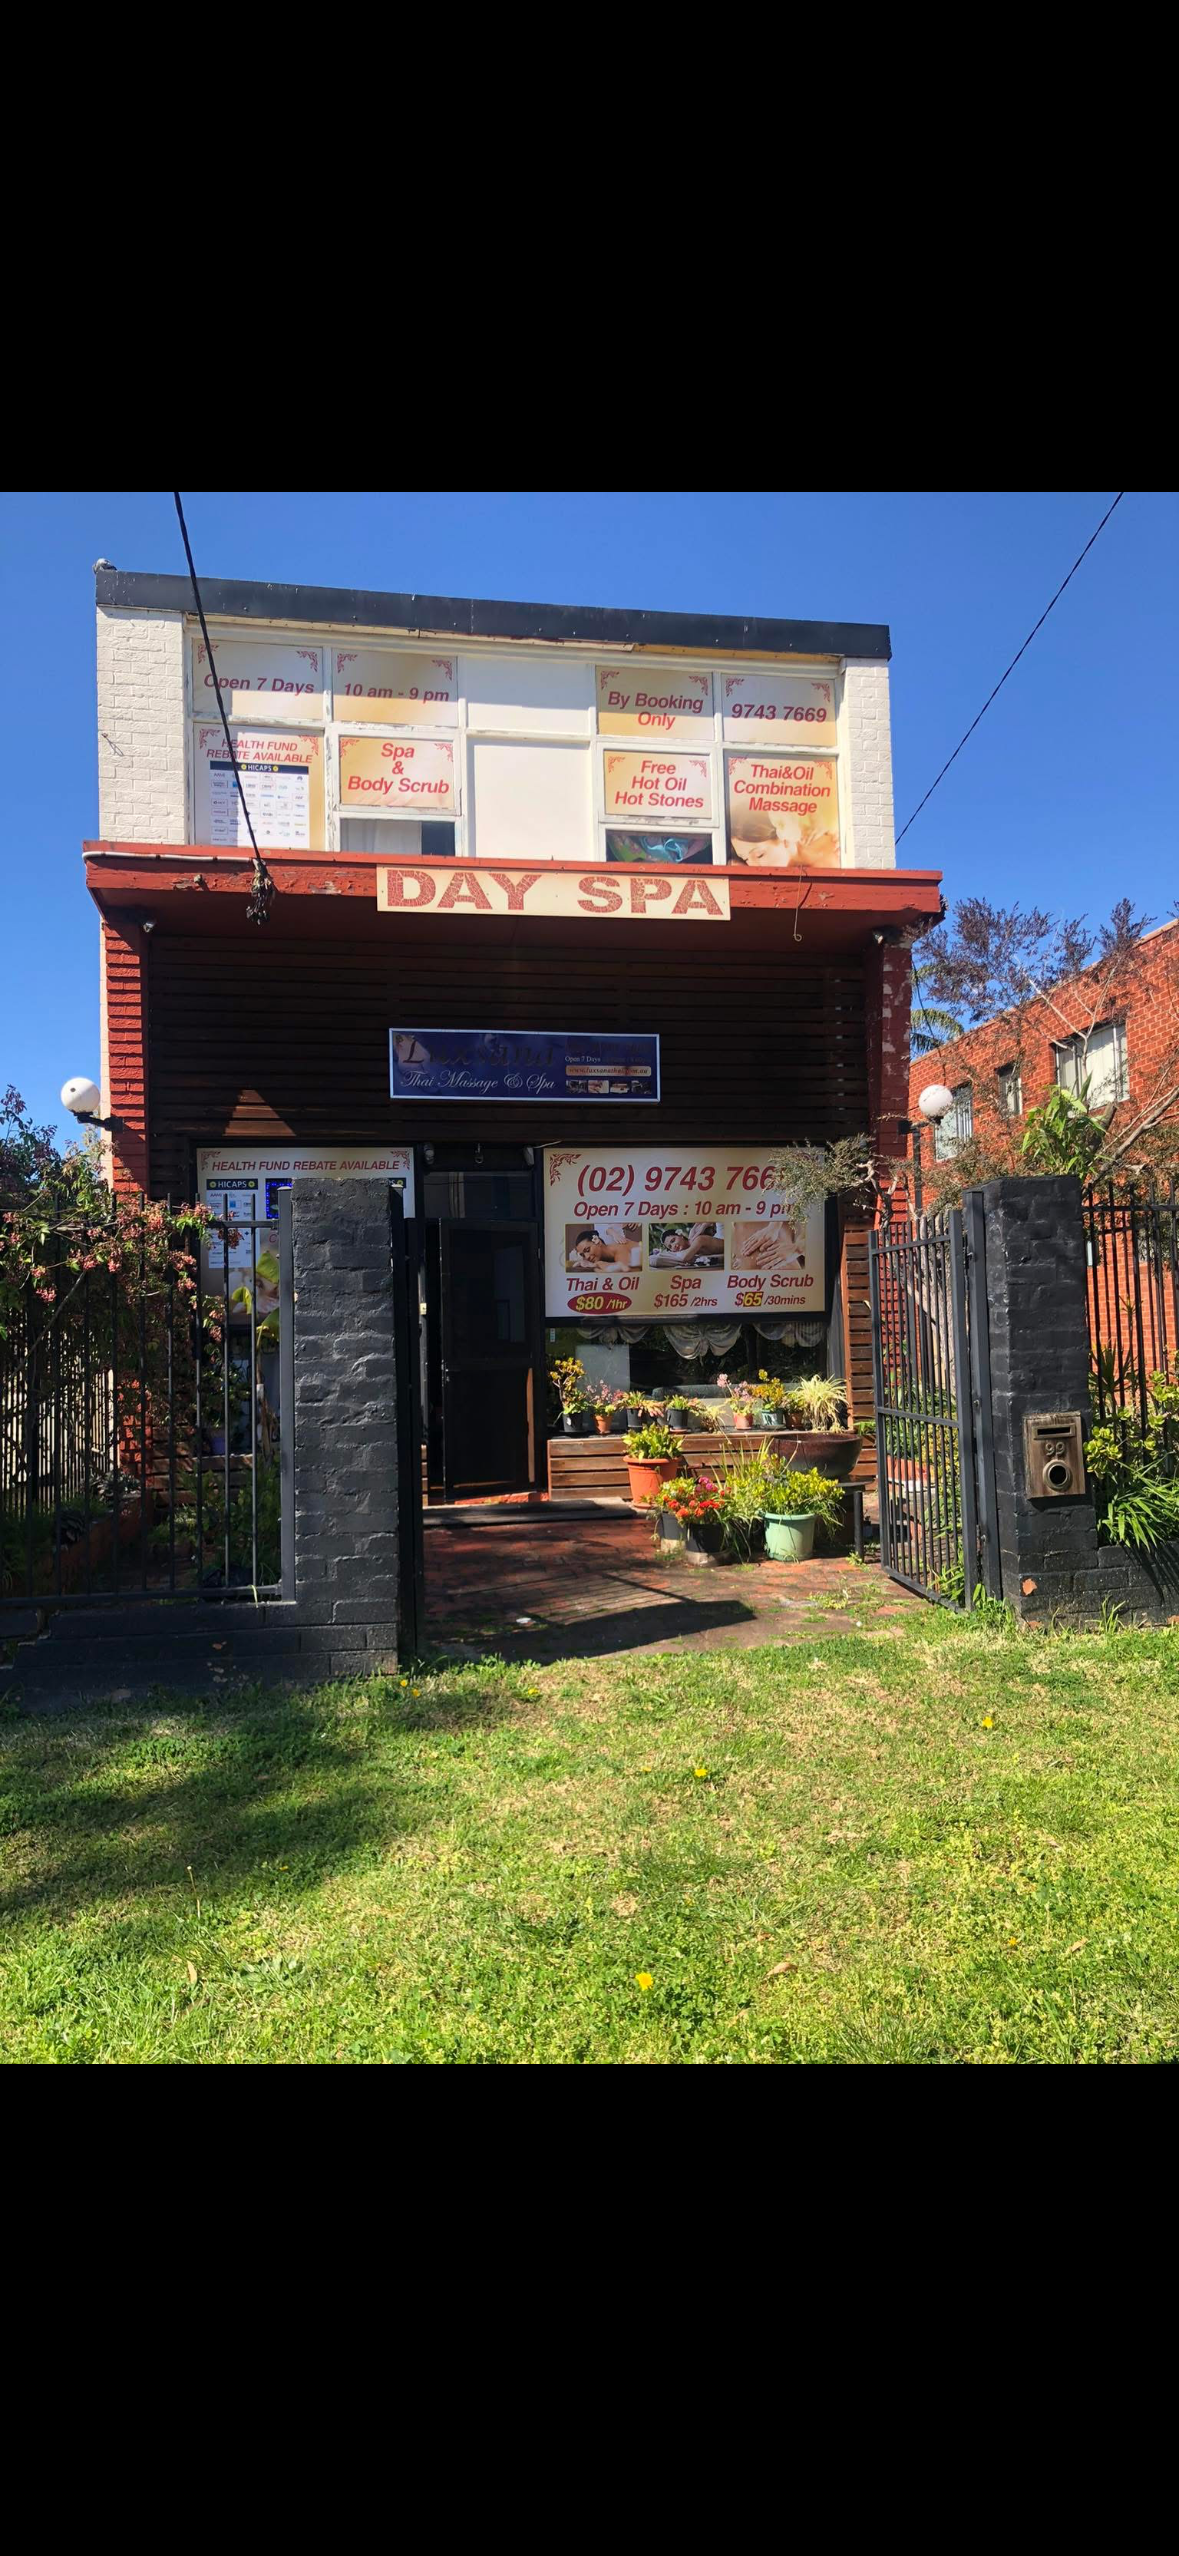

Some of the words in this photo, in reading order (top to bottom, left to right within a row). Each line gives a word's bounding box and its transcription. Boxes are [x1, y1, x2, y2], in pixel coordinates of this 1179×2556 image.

[204, 673, 251, 691] Open
[256, 677, 268, 691] 7
[271, 678, 315, 697] Days
[344, 683, 363, 697] 10
[368, 687, 394, 699] am
[408, 687, 419, 700] 9
[422, 691, 450, 705] pm
[607, 691, 631, 709] By
[634, 692, 704, 714] Booking
[637, 712, 676, 731] Only
[731, 703, 777, 721] 9743
[783, 706, 828, 724] 7669
[221, 738, 265, 750] HEALTH
[267, 741, 298, 752] FUND
[381, 742, 415, 761] Spa
[206, 748, 250, 760] REBATE
[253, 751, 313, 764] AVAILABLE
[247, 764, 272, 772] HICAPS
[391, 761, 404, 775] &
[640, 759, 677, 775] Free
[750, 764, 815, 781] Thai&Oil
[347, 776, 394, 795] Body
[397, 777, 450, 795] Scrub
[631, 775, 660, 791] Hot
[664, 776, 688, 792] Oil
[733, 780, 831, 798] Combination
[614, 791, 644, 807] Hot
[648, 792, 705, 809] Stones
[748, 797, 818, 816] Massage
[386, 869, 543, 911] DAY
[576, 875, 724, 916] SPA
[564, 1055, 580, 1064] Open
[586, 1055, 602, 1064] Days
[400, 1070, 435, 1089] Thai
[437, 1069, 499, 1095] Massage
[503, 1072, 524, 1090] &
[526, 1072, 557, 1095] Spa
[212, 1160, 256, 1171] HEALTH
[258, 1160, 291, 1171] FUND
[293, 1160, 337, 1171] REBATE
[340, 1160, 400, 1171] AVAILABLE
[217, 1180, 247, 1188] HICAPS
[577, 1164, 636, 1197] (02)
[644, 1166, 716, 1192] 9743
[725, 1165, 788, 1191] 766
[574, 1201, 619, 1220] Open
[623, 1202, 635, 1216] 7
[637, 1201, 679, 1220] Days
[694, 1201, 713, 1216] 10
[715, 1203, 741, 1216] am
[755, 1200, 766, 1215] 9
[566, 1276, 599, 1292] Thai
[602, 1277, 614, 1291] &
[618, 1276, 640, 1291] Oil
[670, 1275, 702, 1293] Spa
[727, 1275, 765, 1292] Body
[767, 1274, 814, 1289] Scrub
[575, 1296, 604, 1312] $80
[606, 1298, 628, 1310] /1hr
[653, 1293, 689, 1309] $165
[690, 1296, 718, 1308] /2hrs
[734, 1292, 763, 1307] $65
[763, 1294, 806, 1306] /30mins
[1045, 1441, 1065, 1456] 99
